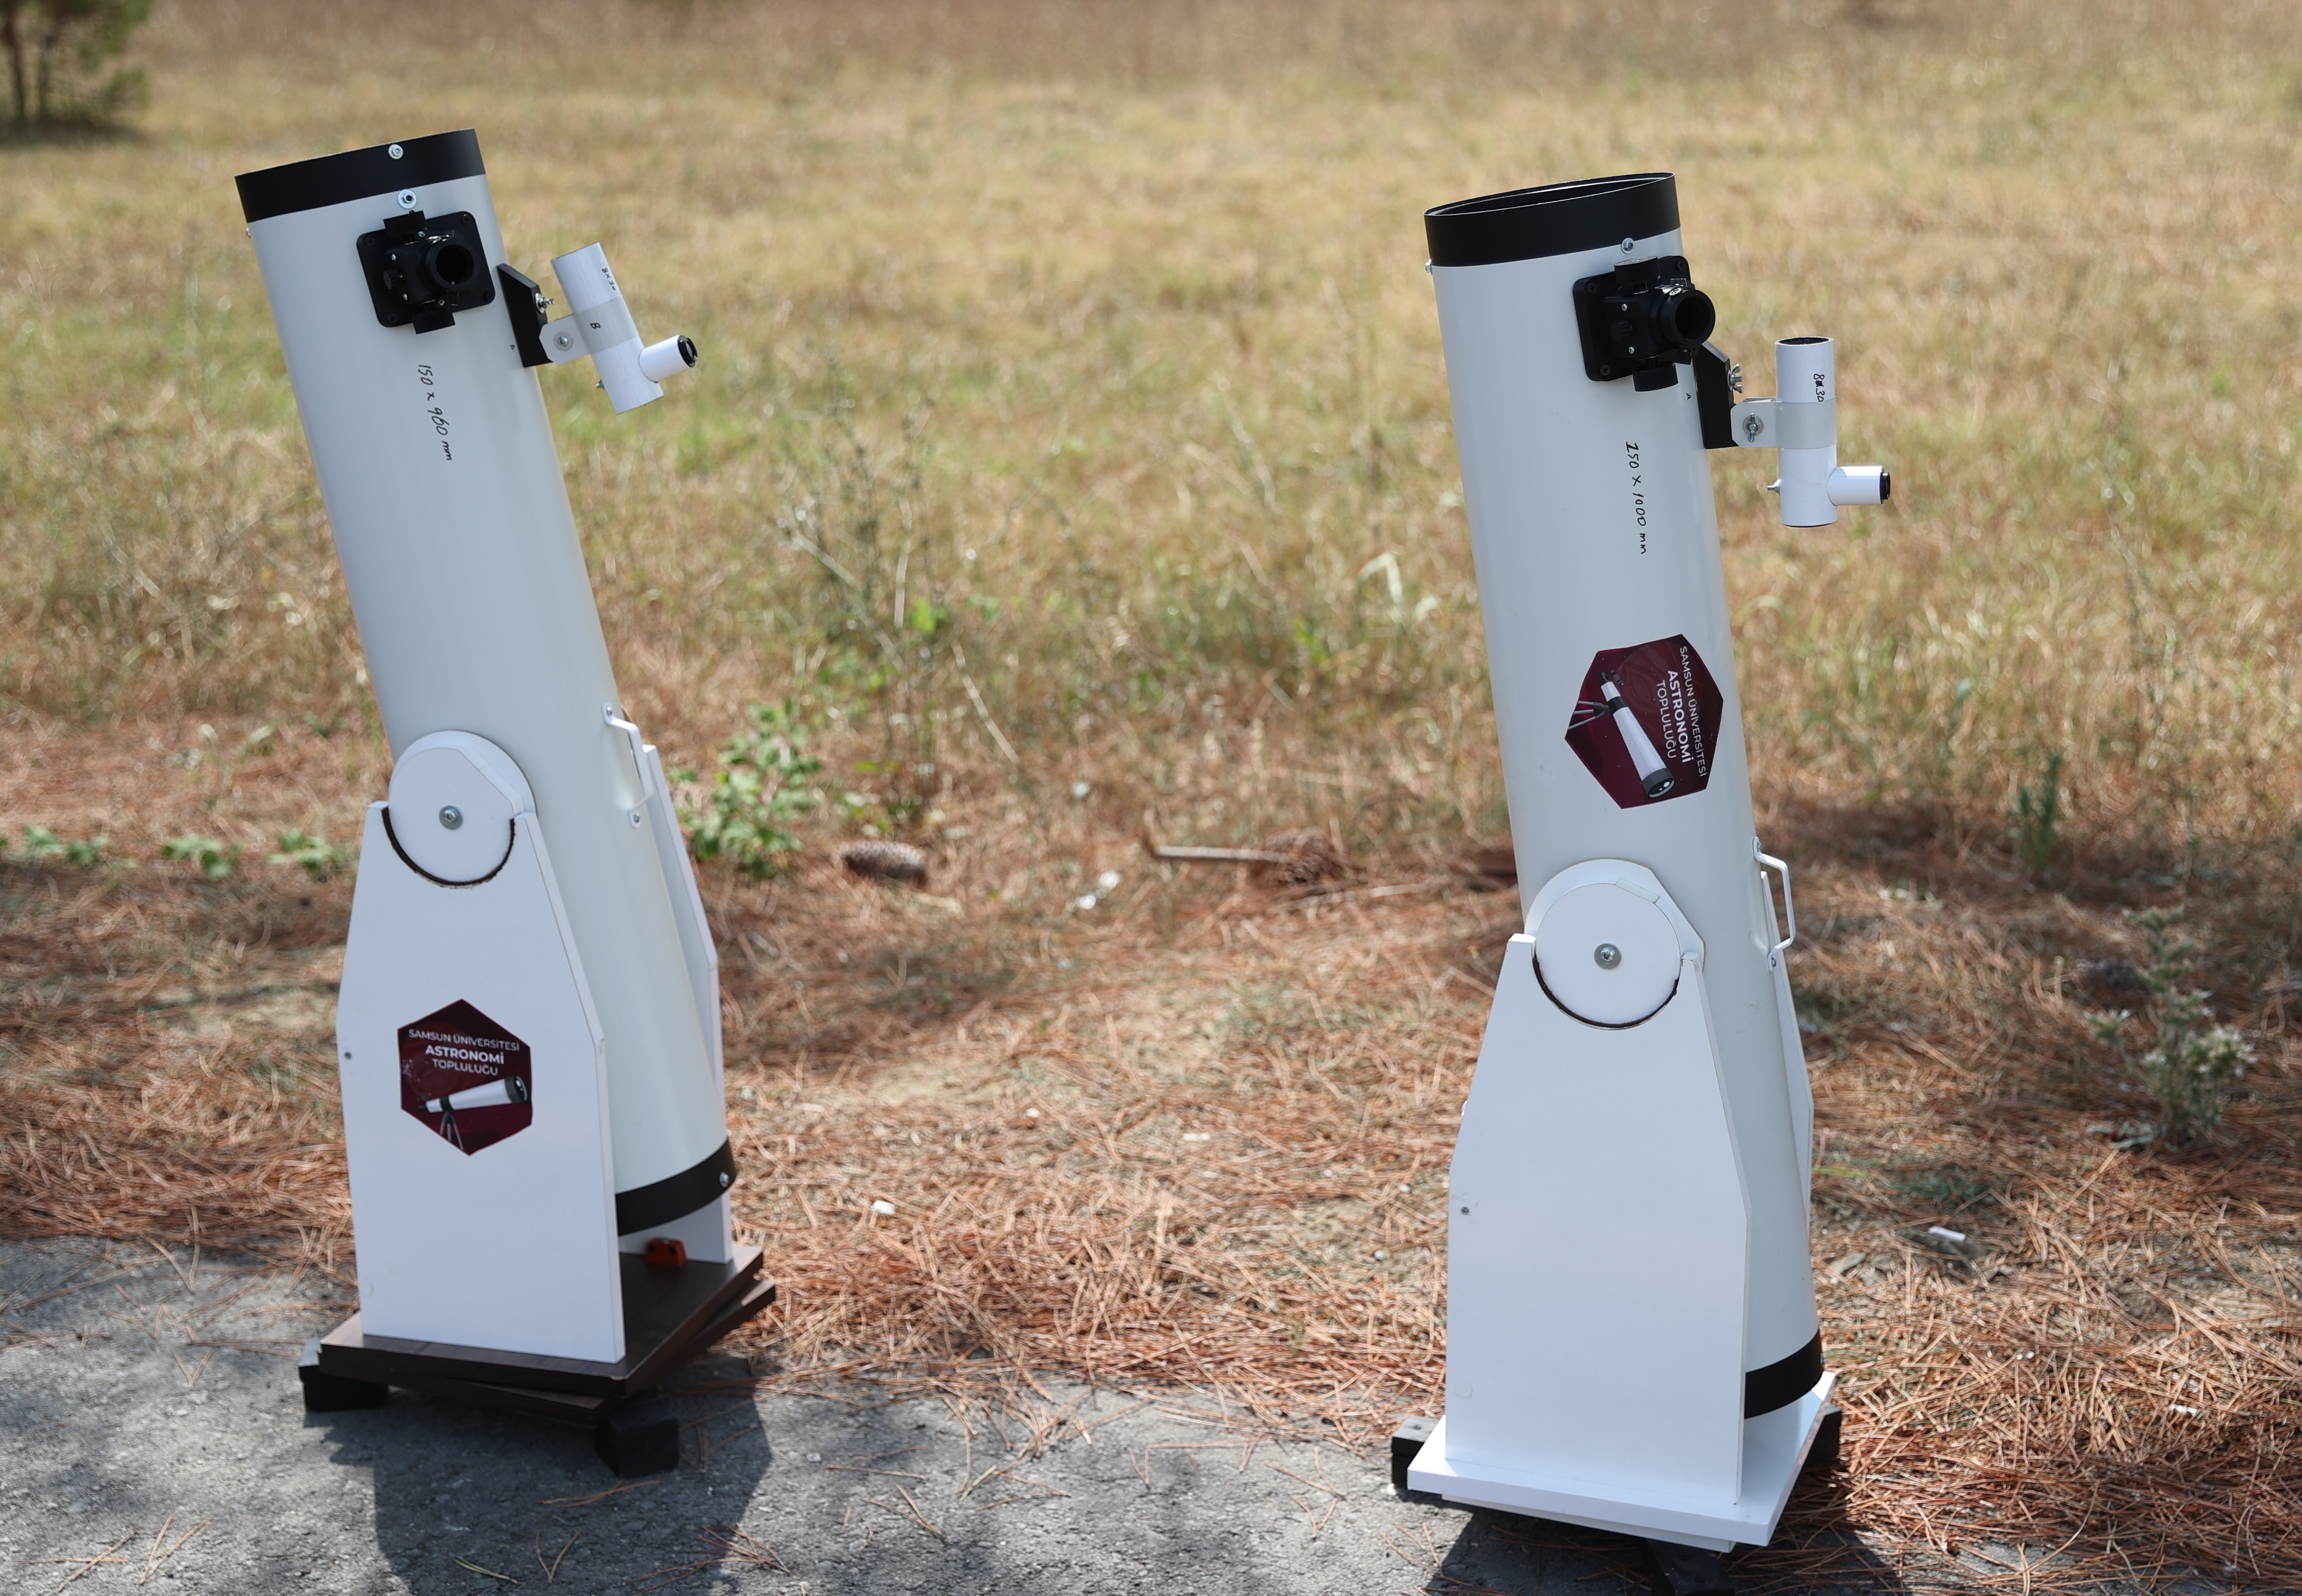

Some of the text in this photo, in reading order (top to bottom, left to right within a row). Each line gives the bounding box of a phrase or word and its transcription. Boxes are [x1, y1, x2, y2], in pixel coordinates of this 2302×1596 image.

[418, 365, 433, 385] 150
[427, 407, 449, 436] 960
[442, 440, 452, 460] mm
[1632, 493, 1646, 526] 1000
[1639, 533, 1646, 554] mm
[1657, 679, 1677, 758] TOPLULUĞU
[1668, 670, 1695, 763] ASTRONOMİ
[1680, 645, 1708, 777] SAMSUN ÜNİVERSİTESİ
[408, 1029, 520, 1051] SAMSUN ÜNİVERSİTESİ
[425, 1045, 505, 1064] ASTRONOMİ
[432, 1058, 498, 1076] TOPLULUĞU
